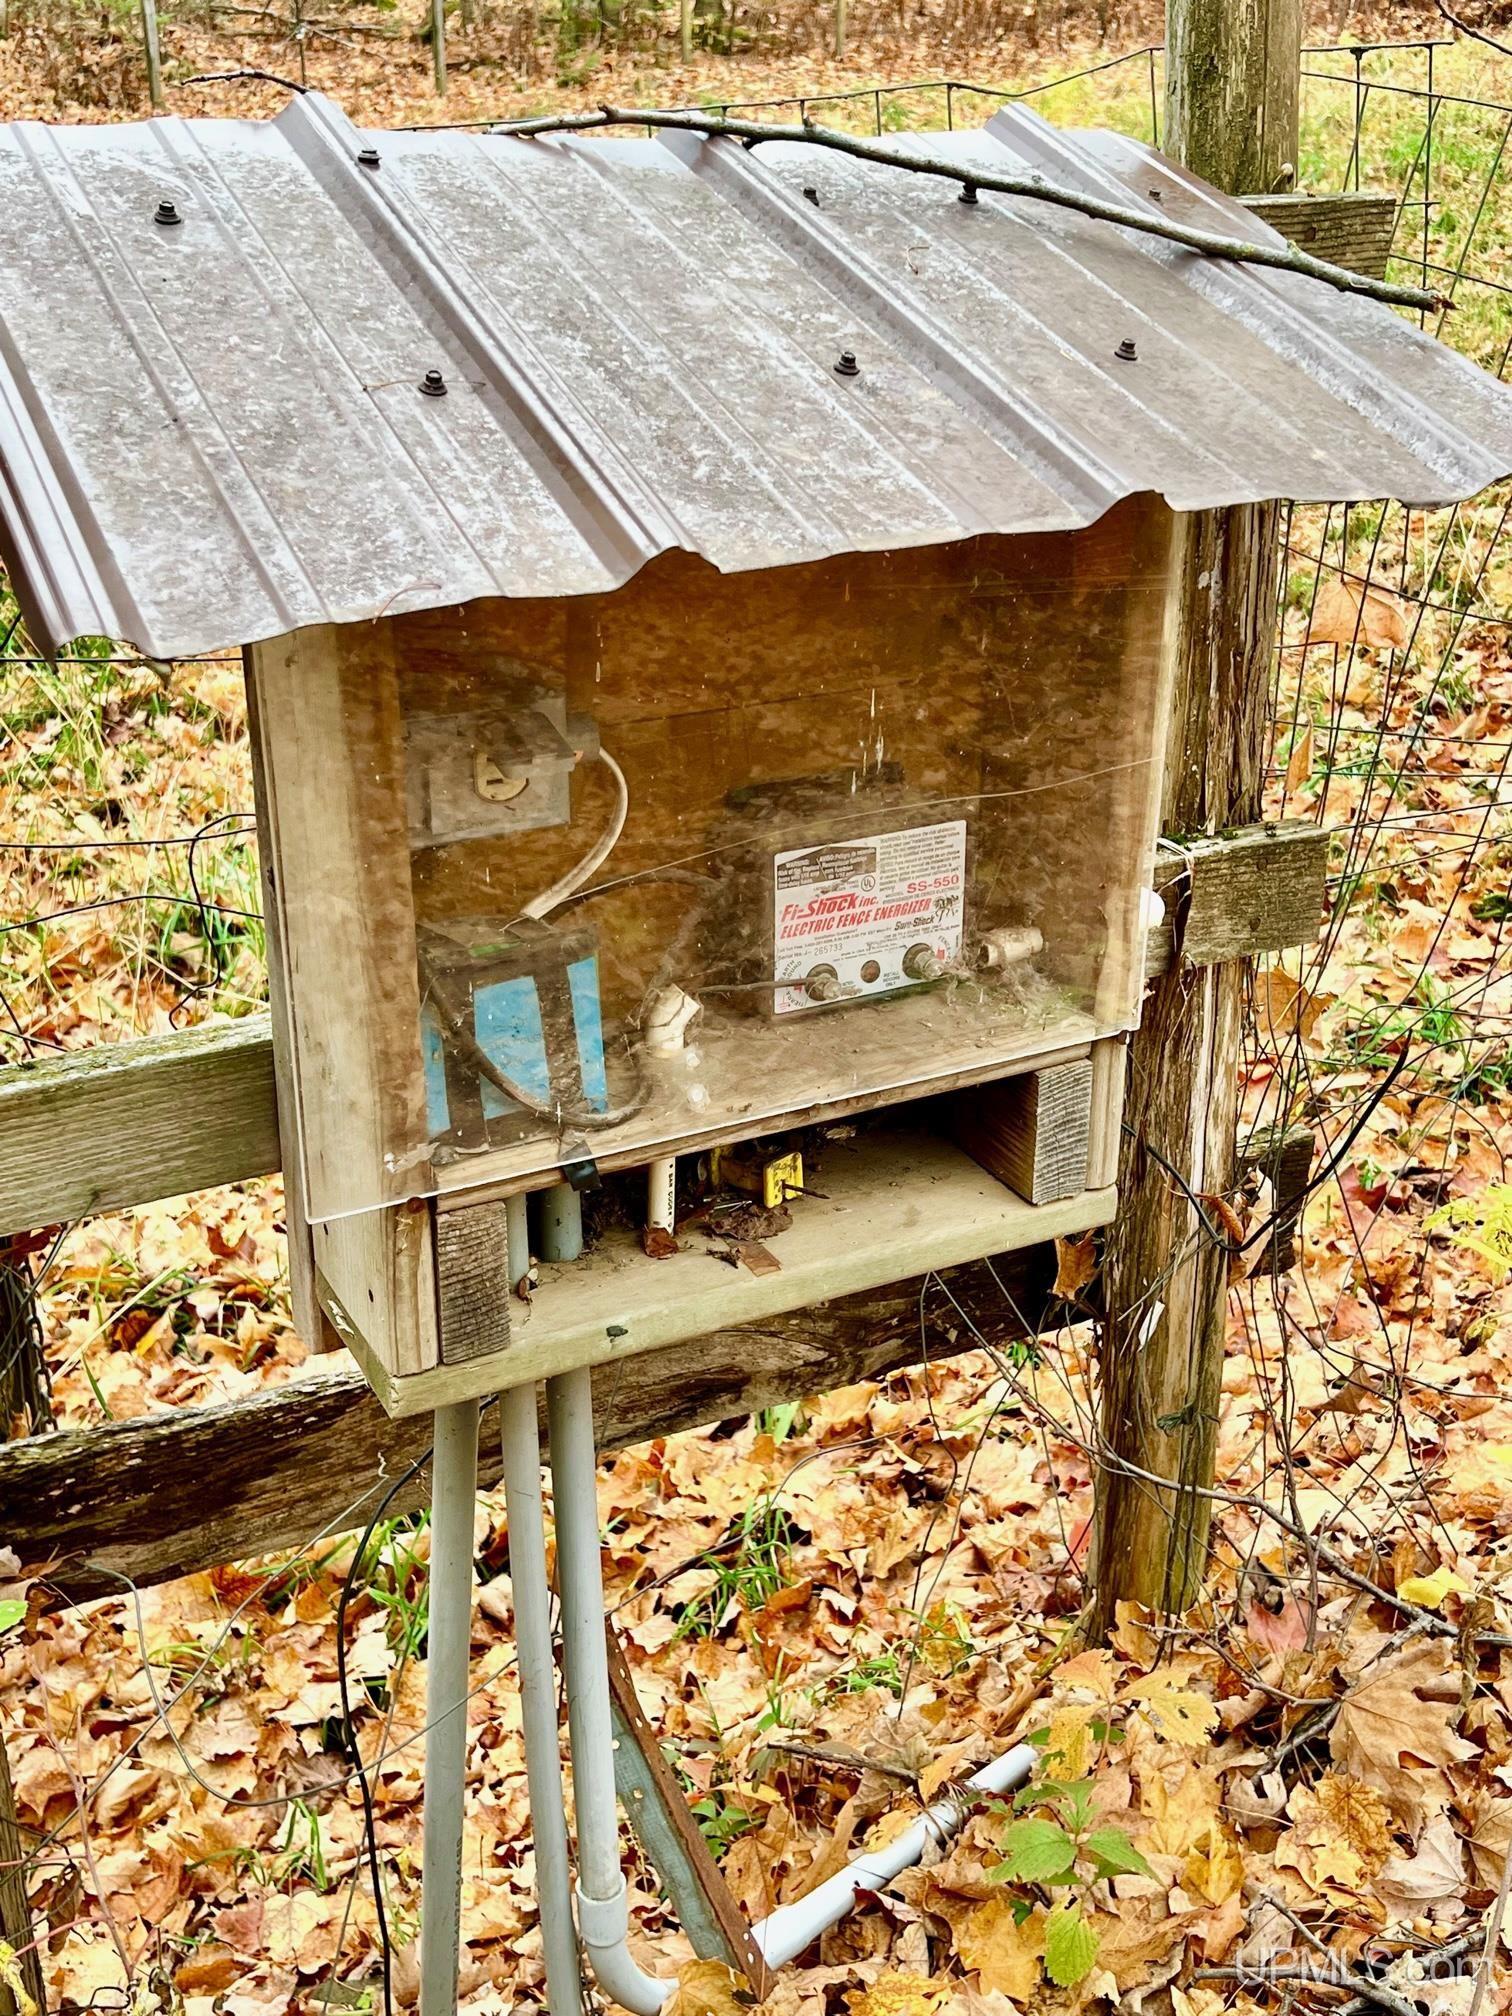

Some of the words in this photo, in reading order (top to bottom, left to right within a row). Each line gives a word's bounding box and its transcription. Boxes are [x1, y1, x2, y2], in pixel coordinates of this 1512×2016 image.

[907, 875, 960, 894] SS-550
[780, 917, 836, 939] ELECTRIC
[836, 910, 870, 929] FENCE
[874, 899, 932, 922] ENERGIZER
[781, 892, 859, 923] Fi-Shock
[858, 896, 879, 908] inc.
[813, 943, 843, 957] 265733
